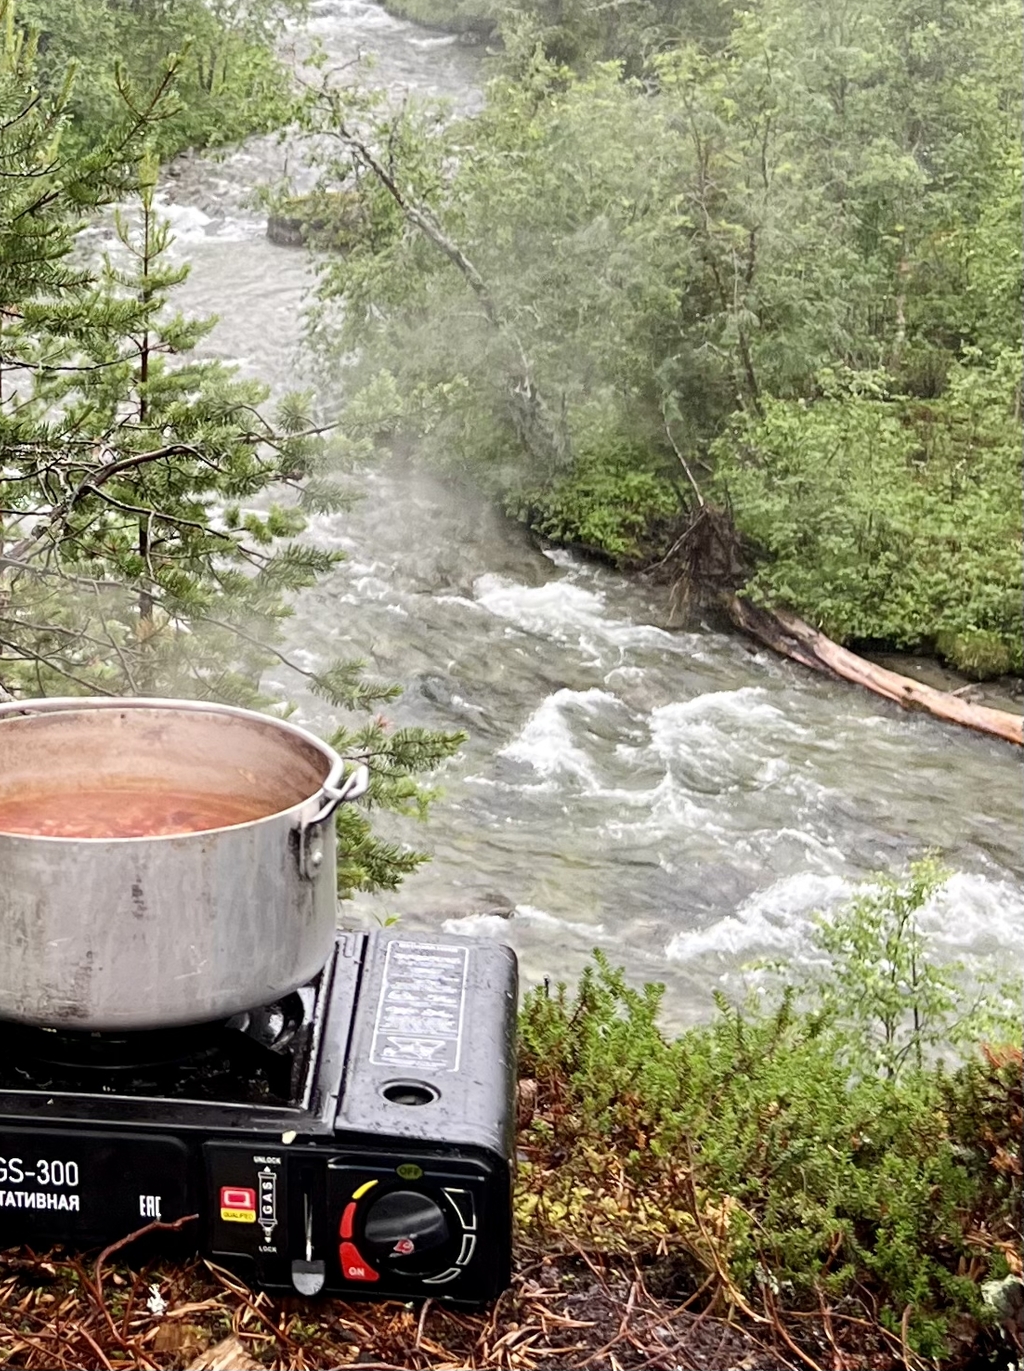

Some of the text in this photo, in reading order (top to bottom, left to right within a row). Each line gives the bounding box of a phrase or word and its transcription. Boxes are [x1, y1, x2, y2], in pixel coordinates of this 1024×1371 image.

[253, 1156, 281, 1165] UNLOCK
[399, 1166, 420, 1176] OFF
[262, 1181, 273, 1215] GAS
[258, 1245, 277, 1253] LOCK
[348, 1267, 365, 1277] ON
